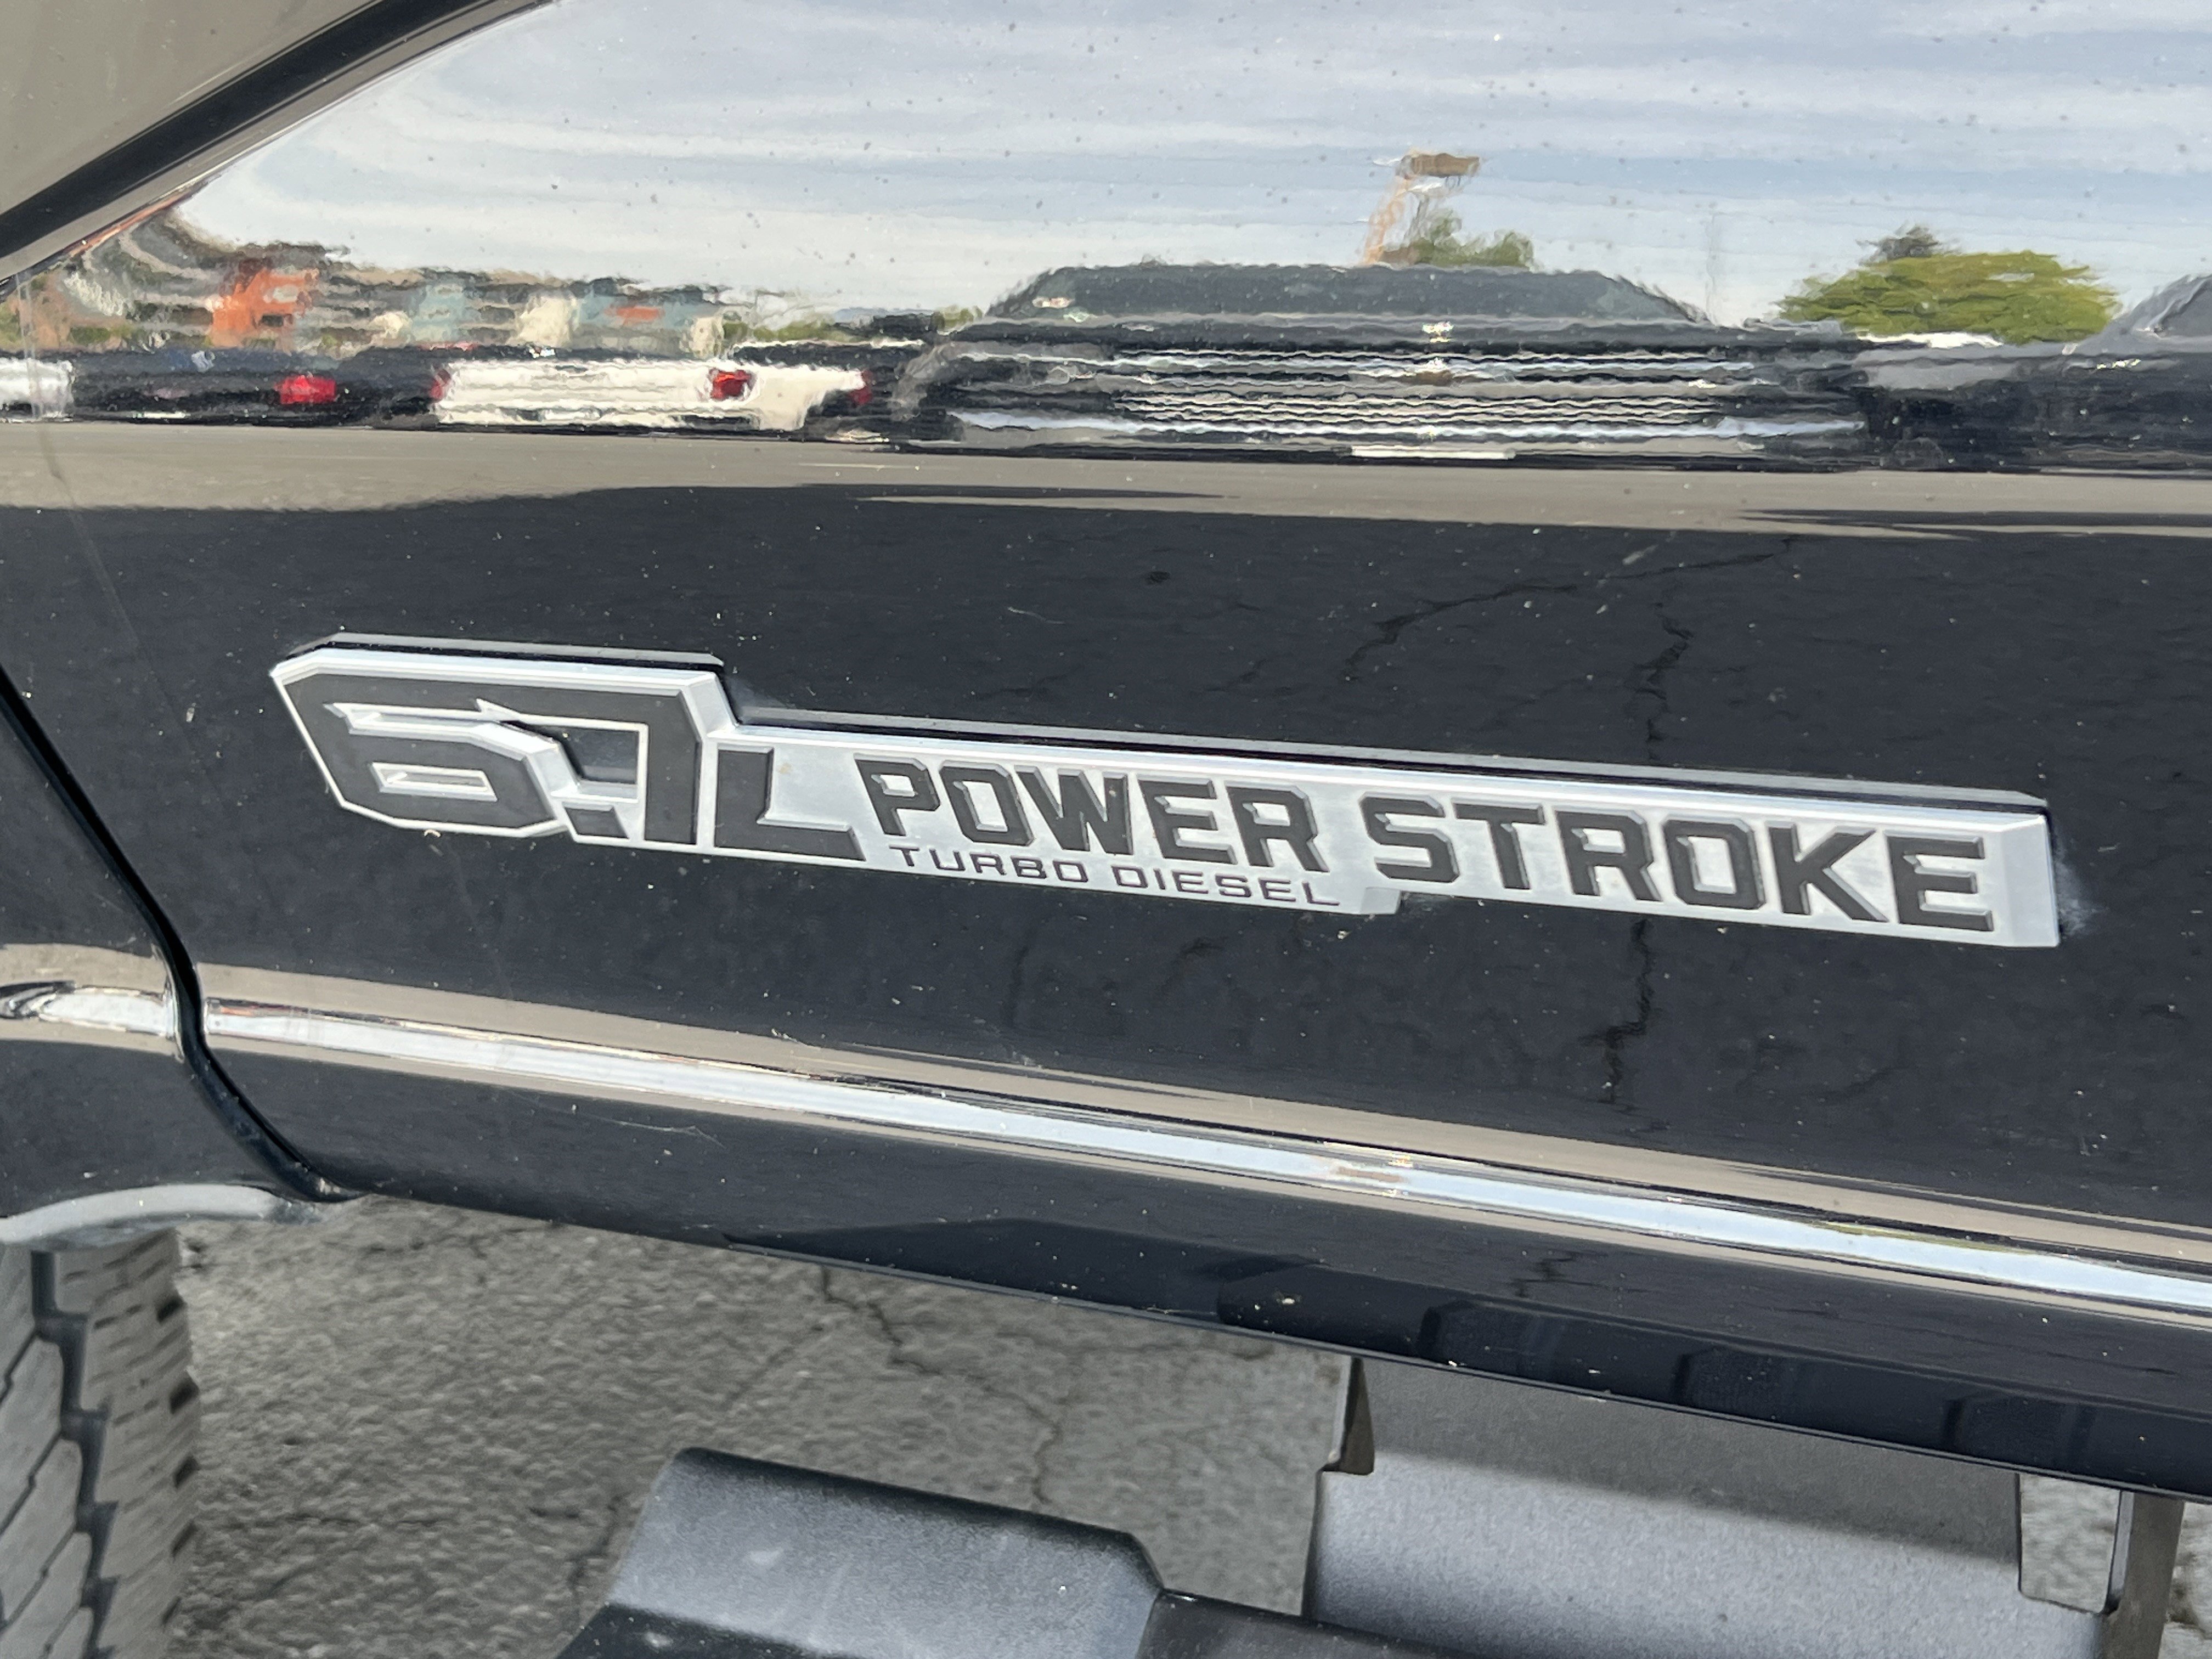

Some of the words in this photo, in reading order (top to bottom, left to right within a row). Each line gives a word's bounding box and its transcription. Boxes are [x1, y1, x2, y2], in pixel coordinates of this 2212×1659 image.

[280, 670, 867, 861] 6.7L
[854, 753, 1330, 873] POWER
[1358, 792, 1995, 932] STROKE
[889, 845, 1089, 883] TURBO
[1113, 865, 1340, 906] DIESEL
